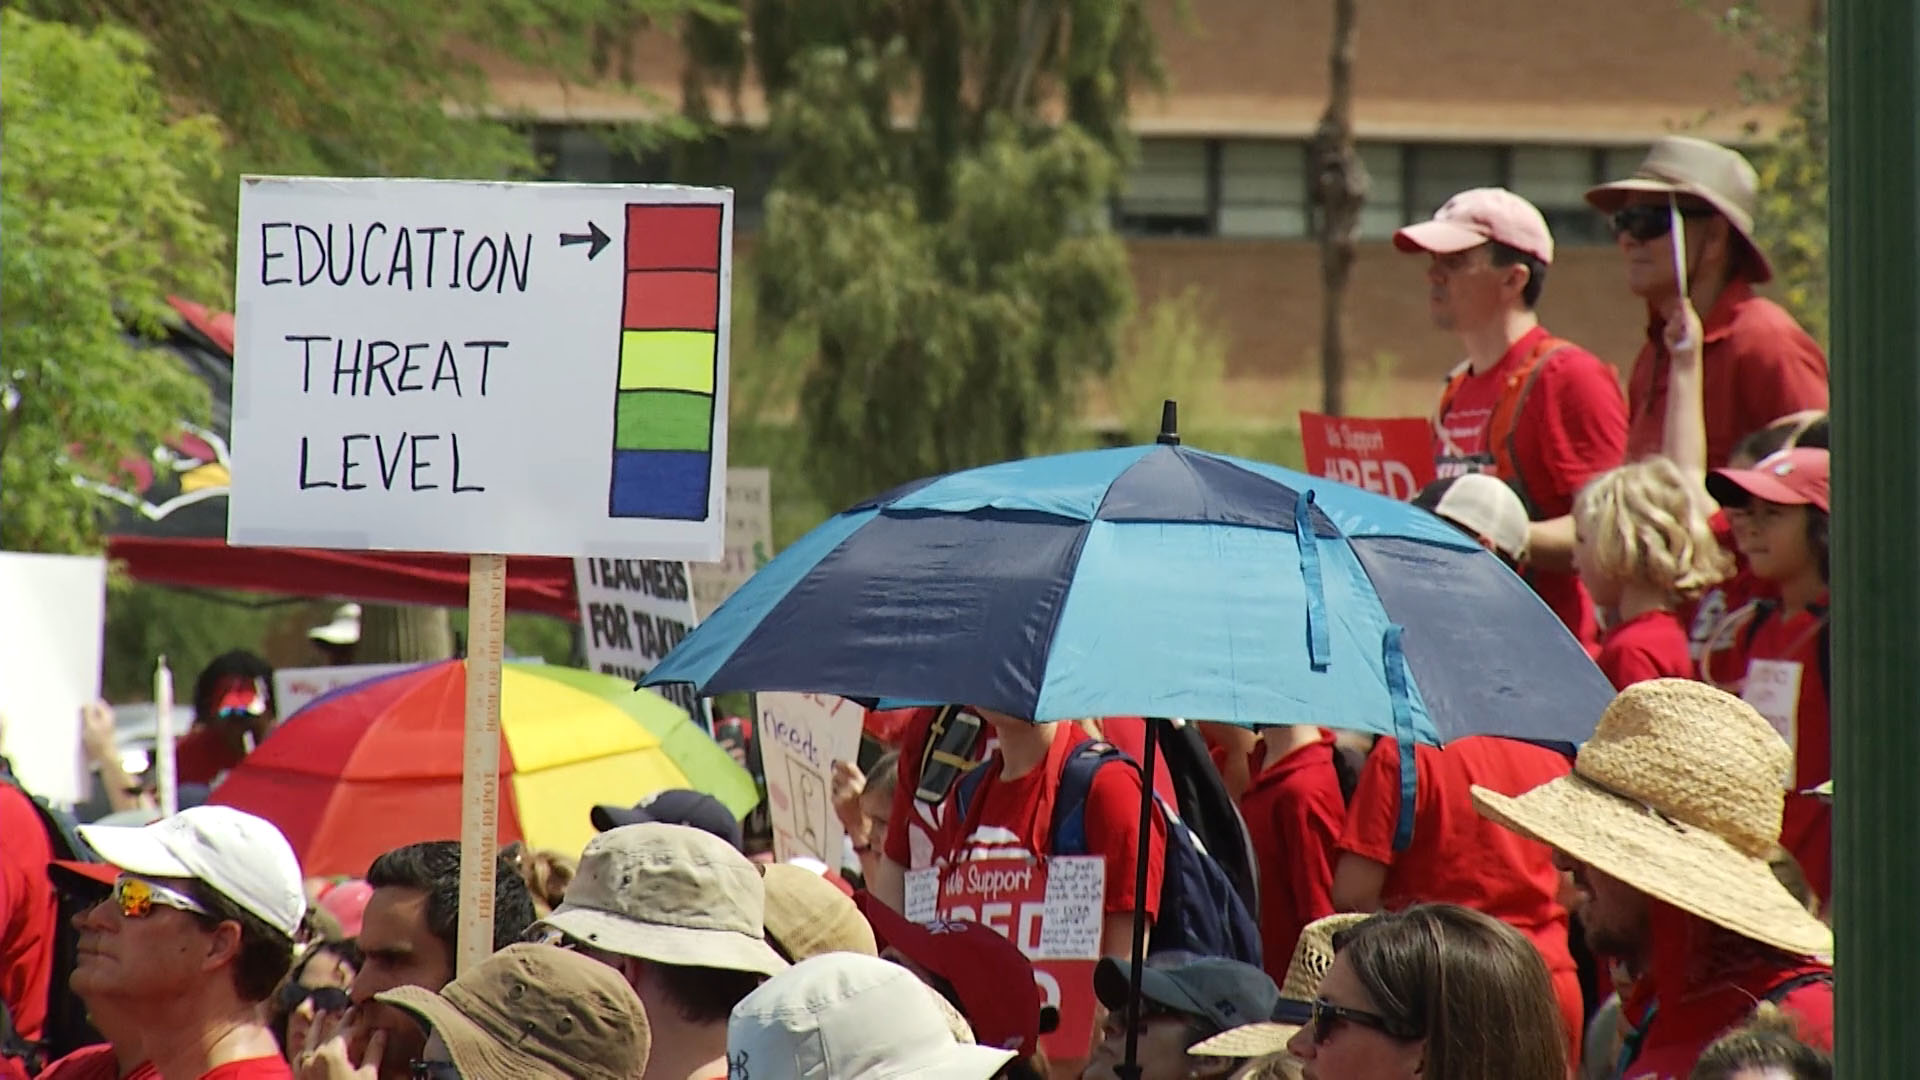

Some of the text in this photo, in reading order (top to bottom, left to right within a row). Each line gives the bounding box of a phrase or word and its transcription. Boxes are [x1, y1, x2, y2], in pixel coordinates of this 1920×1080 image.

[261, 222, 532, 293] EDUCATION
[285, 335, 510, 397] THREAT
[299, 432, 485, 493] LEVEL
[588, 557, 689, 602] TEACHERS
[589, 602, 632, 650] FOR
[479, 772, 495, 920] THE HOME DEPOT
[967, 864, 1033, 901] Support
